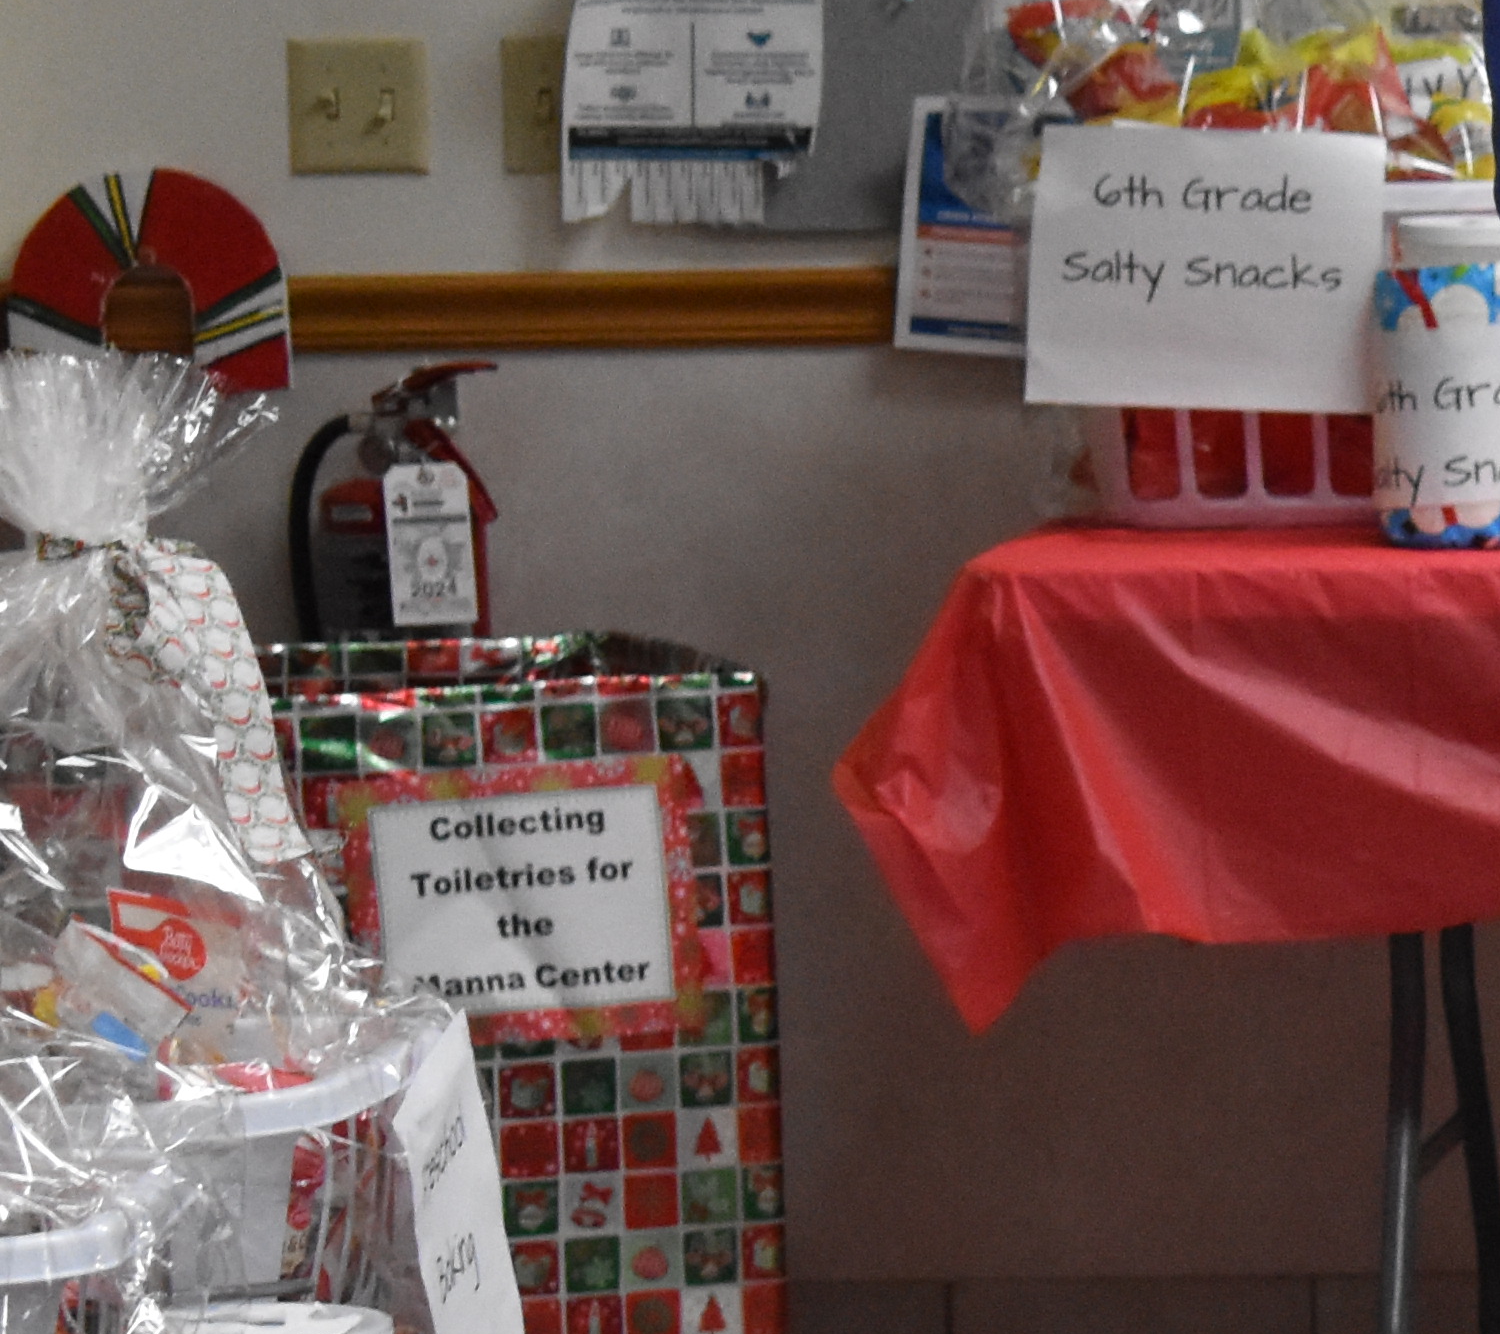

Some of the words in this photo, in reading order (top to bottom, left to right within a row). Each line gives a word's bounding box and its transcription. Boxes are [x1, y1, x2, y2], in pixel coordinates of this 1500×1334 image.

[1093, 174, 1165, 209] 6th
[1182, 174, 1313, 214] Grade
[1061, 251, 1166, 304] Salty
[1184, 254, 1344, 293] Snacks
[411, 576, 458, 598] 2024
[429, 807, 606, 842] Collecting
[409, 863, 577, 898] Toiletries
[586, 856, 634, 883] for
[496, 913, 555, 939] the
[535, 960, 652, 989] Center
